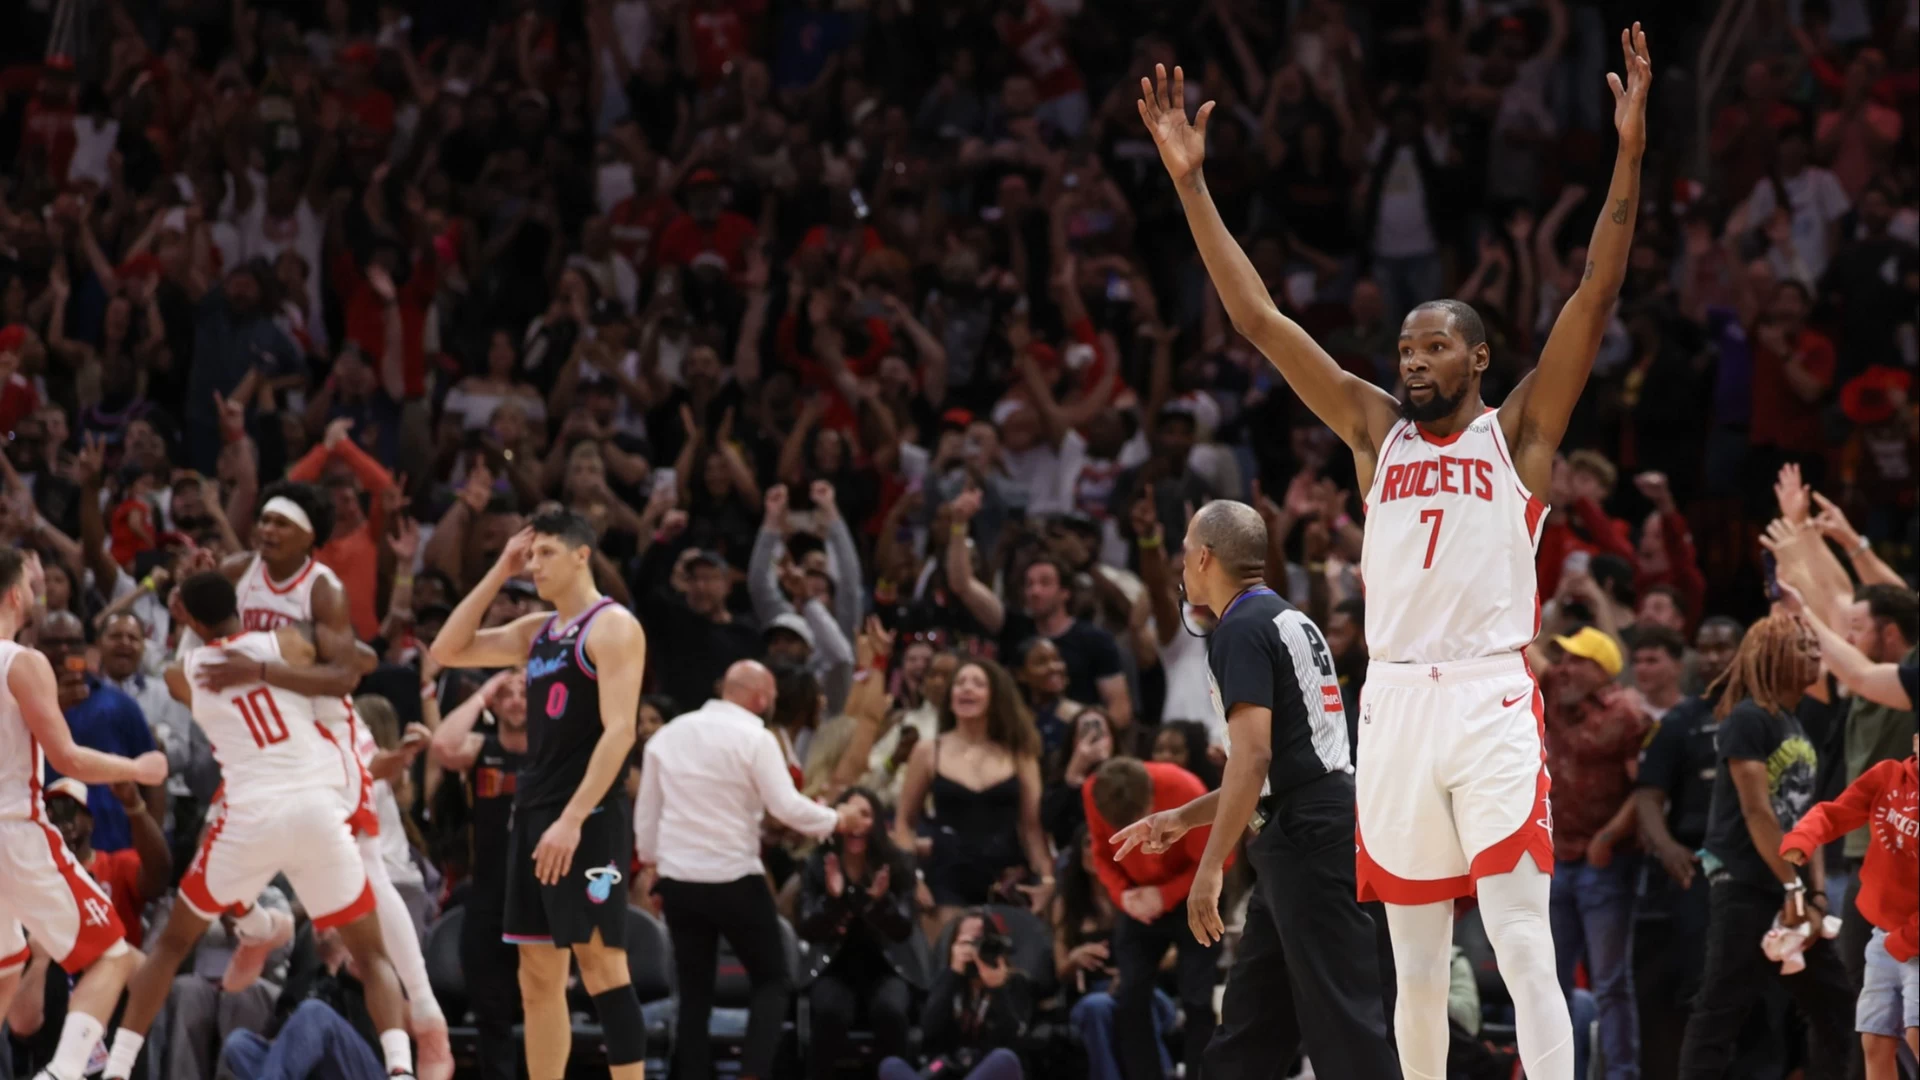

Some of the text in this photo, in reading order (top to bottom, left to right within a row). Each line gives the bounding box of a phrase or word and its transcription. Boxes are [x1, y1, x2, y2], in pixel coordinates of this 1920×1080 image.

[1380, 454, 1493, 504] ROCETS
[1419, 508, 1444, 570] 7
[231, 686, 289, 749] 10
[545, 681, 568, 719] 0
